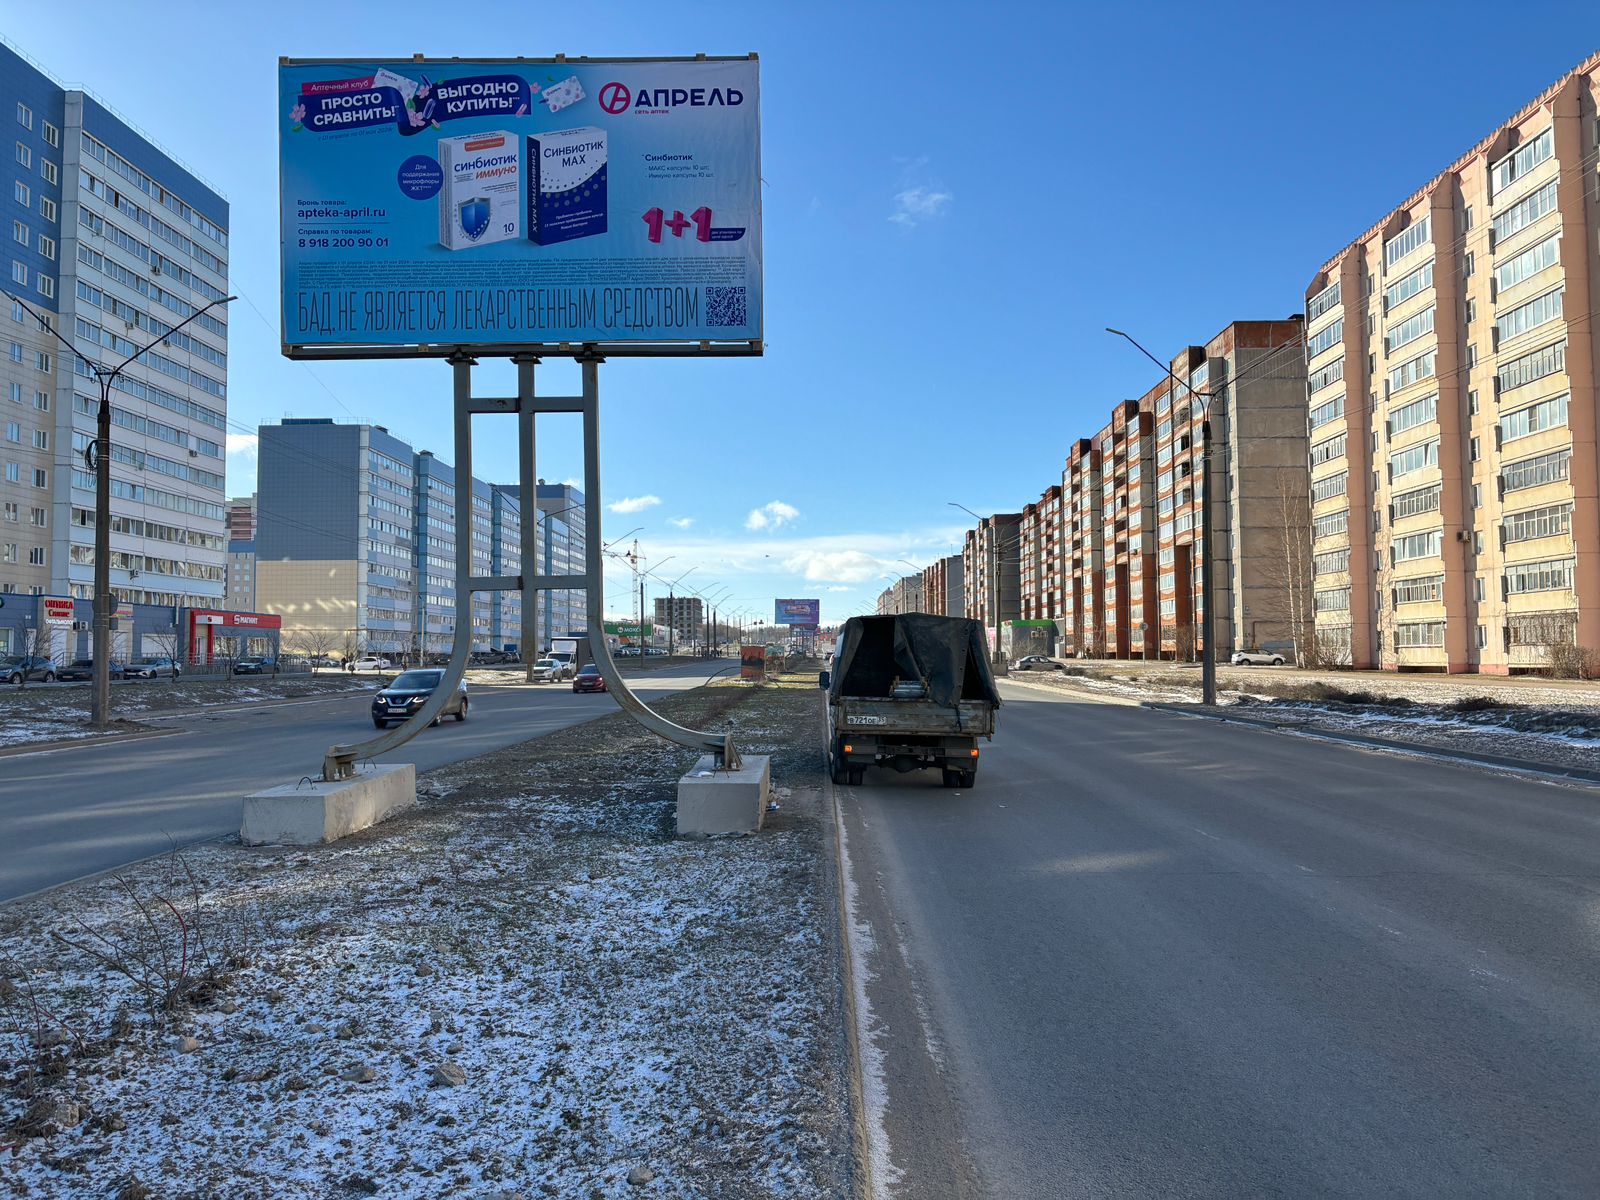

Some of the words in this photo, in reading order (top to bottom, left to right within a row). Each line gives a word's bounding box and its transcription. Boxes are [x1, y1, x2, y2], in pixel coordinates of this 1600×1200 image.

[311, 82, 349, 92] Аптечный
[350, 80, 369, 89] клуб
[437, 82, 519, 100] ВЫГОДНО
[321, 92, 382, 110] ПРОСТО
[447, 96, 513, 114] КУПИТЬ!
[634, 88, 744, 108] АПРЕЛЬ
[313, 105, 396, 126] СРАВНИТЬ!
[645, 153, 693, 161] Синбиотик
[297, 207, 386, 219] apteka-april.ru
[298, 228, 329, 236] Справка
[503, 222, 515, 233] 10
[641, 206, 712, 243] 1+1
[298, 238, 306, 248] 8
[309, 238, 329, 247] 918
[332, 238, 355, 247] 200
[358, 238, 373, 247] 90
[376, 237, 388, 247] 01
[364, 289, 446, 332] ЯВЛЯЕТСЯ
[453, 288, 597, 330] ЛЕКАРСТВЕННЫМ
[603, 286, 699, 332] СРЕДСТВОМ
